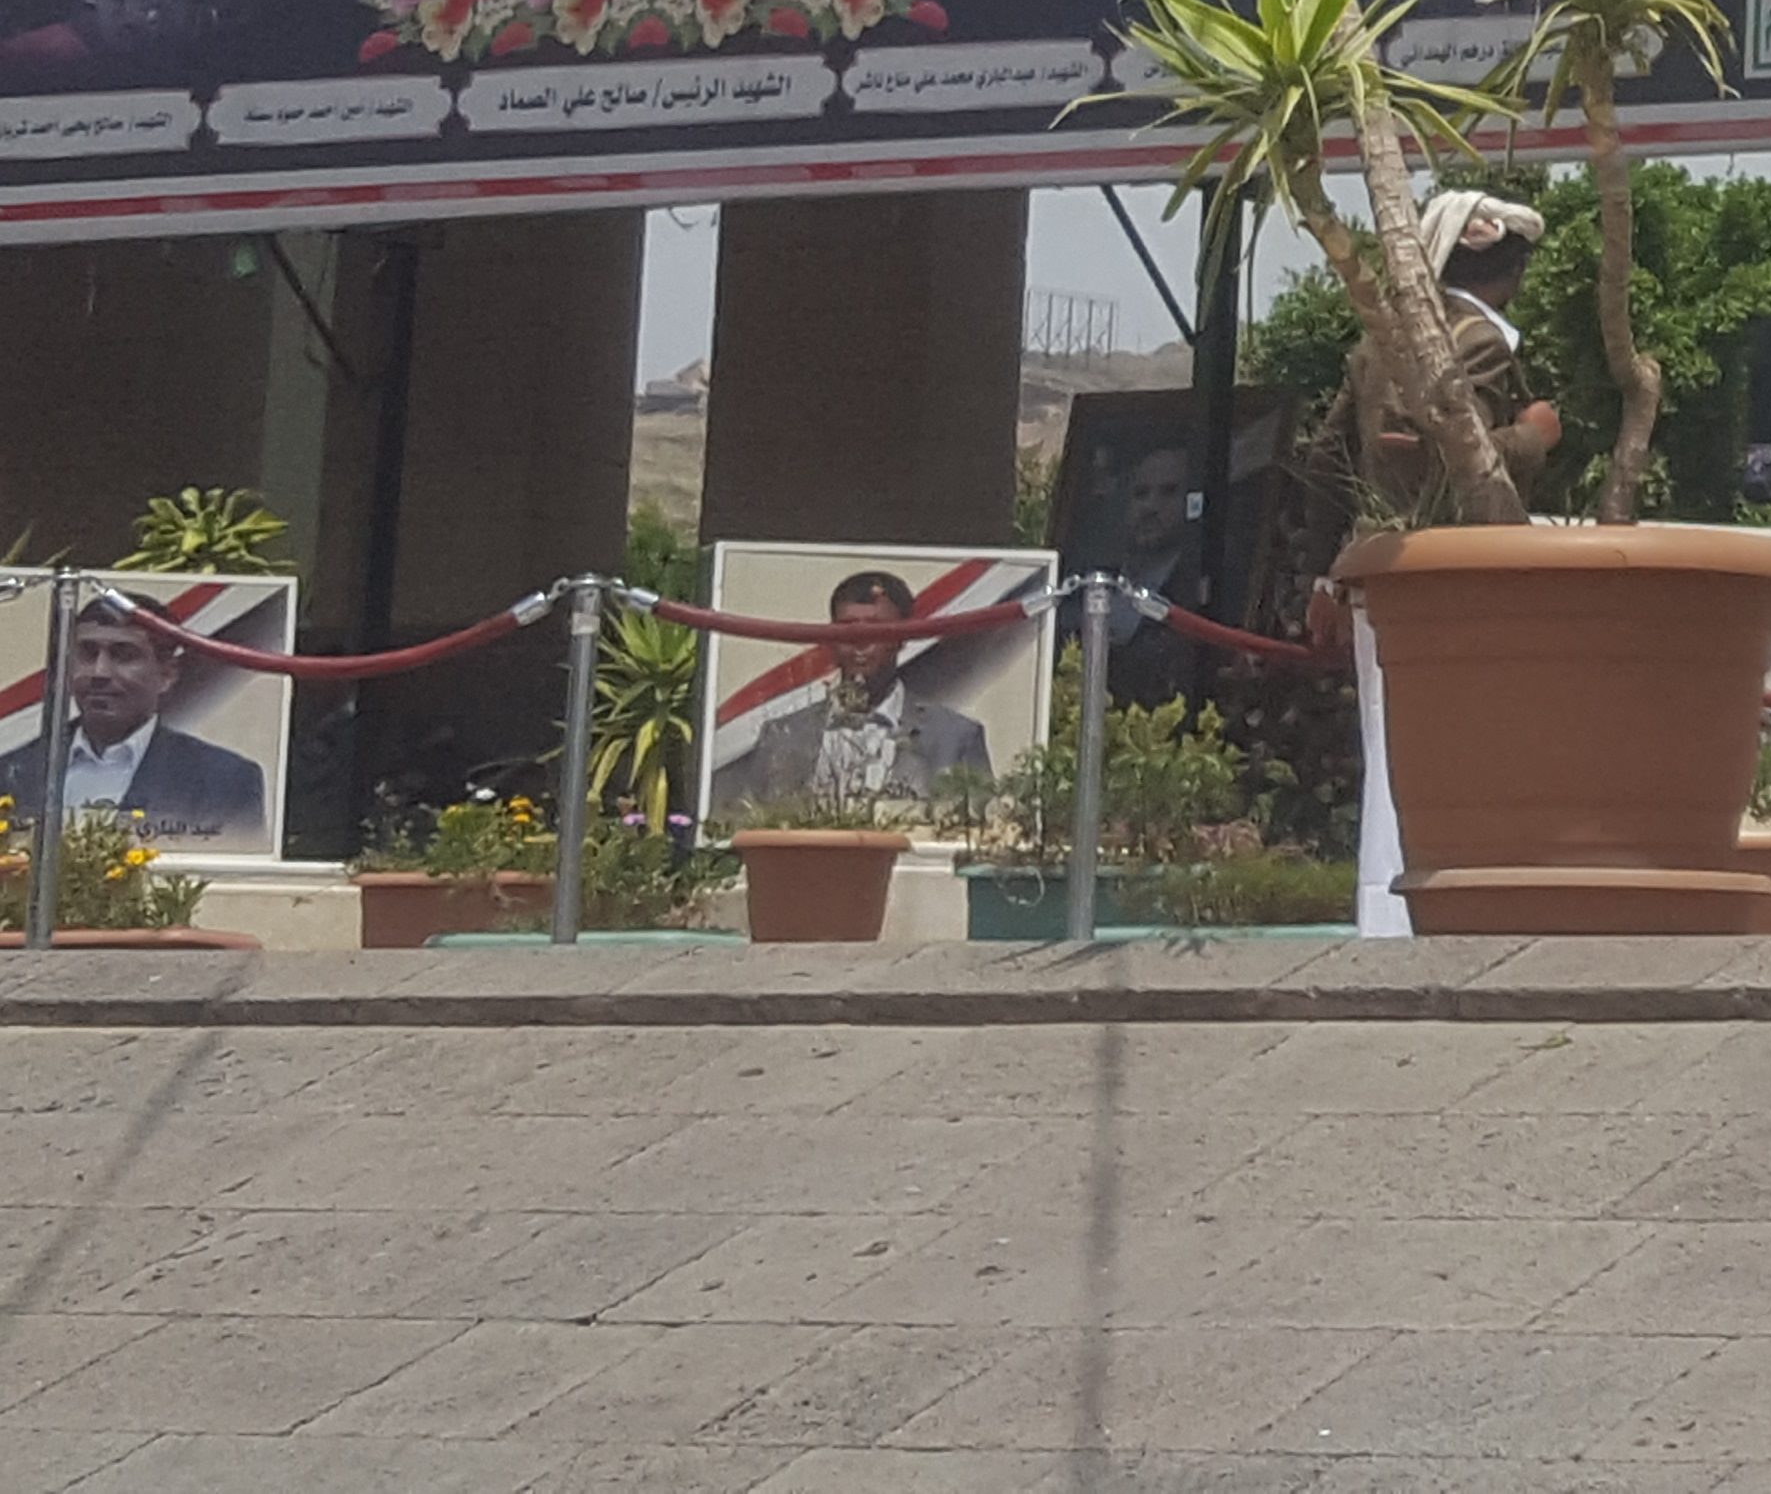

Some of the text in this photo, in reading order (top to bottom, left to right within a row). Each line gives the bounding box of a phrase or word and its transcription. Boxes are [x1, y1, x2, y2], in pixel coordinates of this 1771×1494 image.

[498, 87, 557, 112] الصماد
[561, 85, 596, 119] علي
[600, 83, 648, 113] صالح
[732, 73, 792, 104] الشهيد
